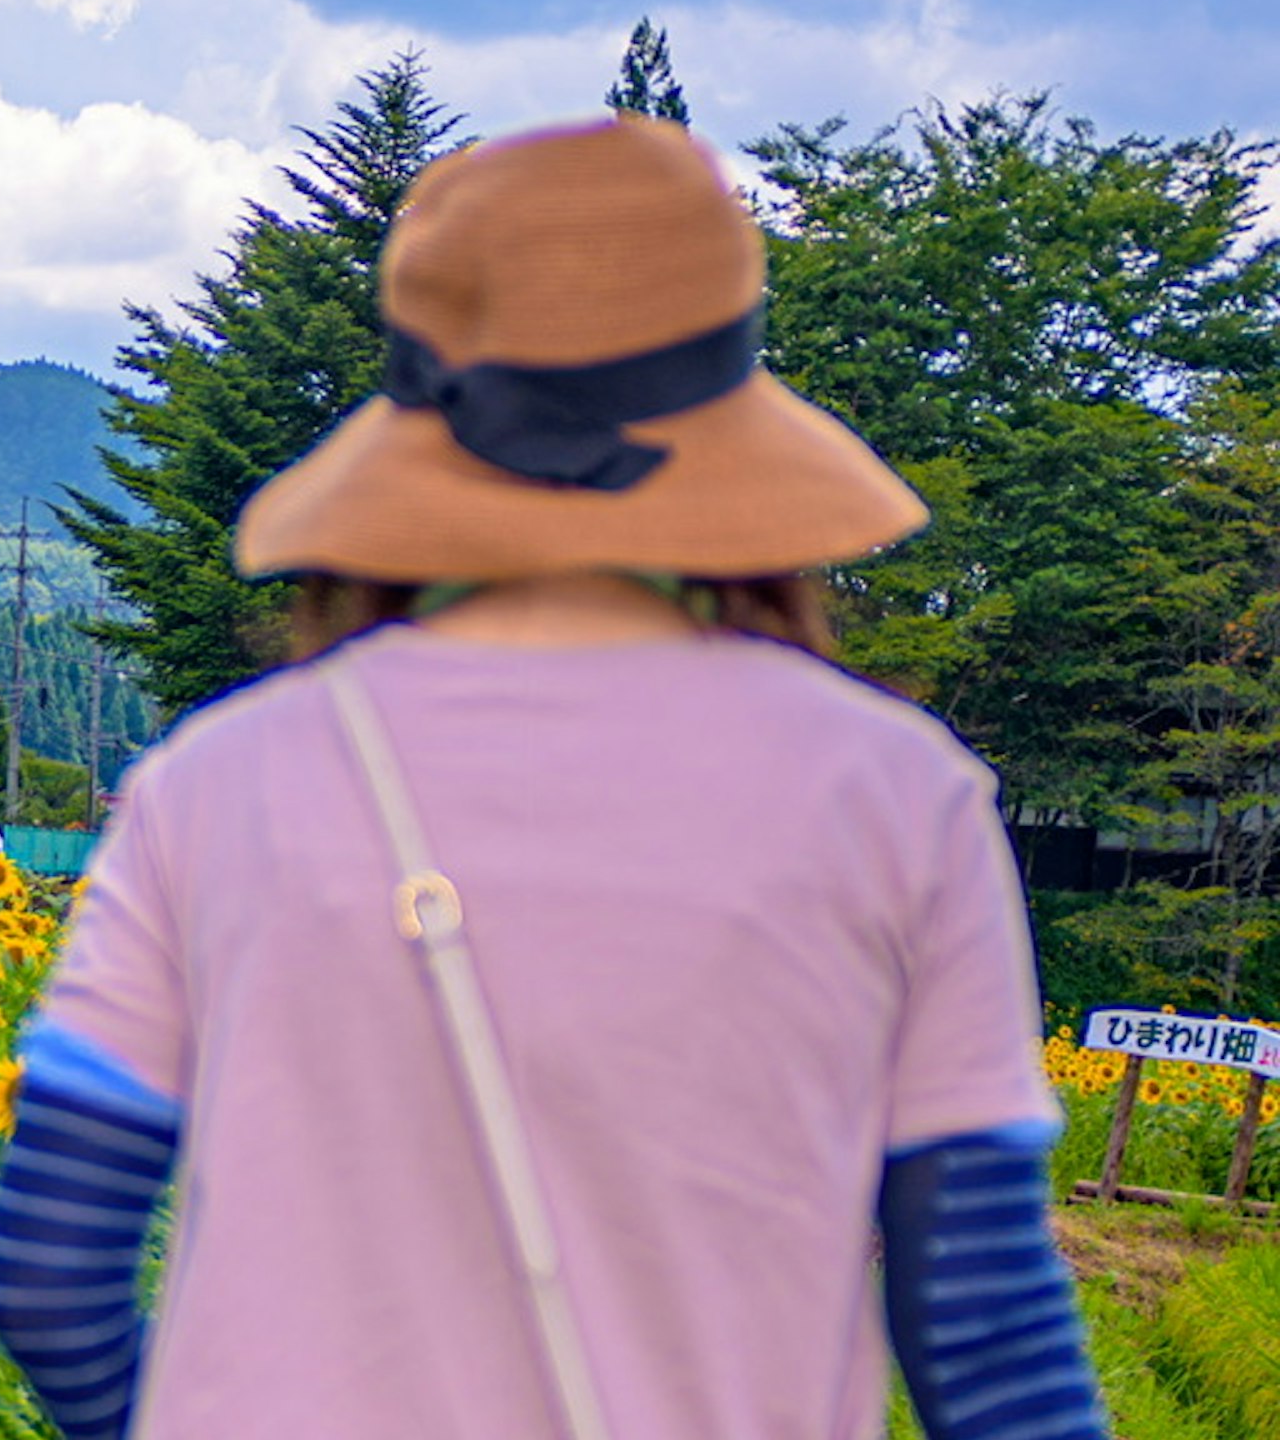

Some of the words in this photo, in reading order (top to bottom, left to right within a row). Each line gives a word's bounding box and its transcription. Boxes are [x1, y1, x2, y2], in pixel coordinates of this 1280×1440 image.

[1107, 1016, 1258, 1063] ひまわり畑
